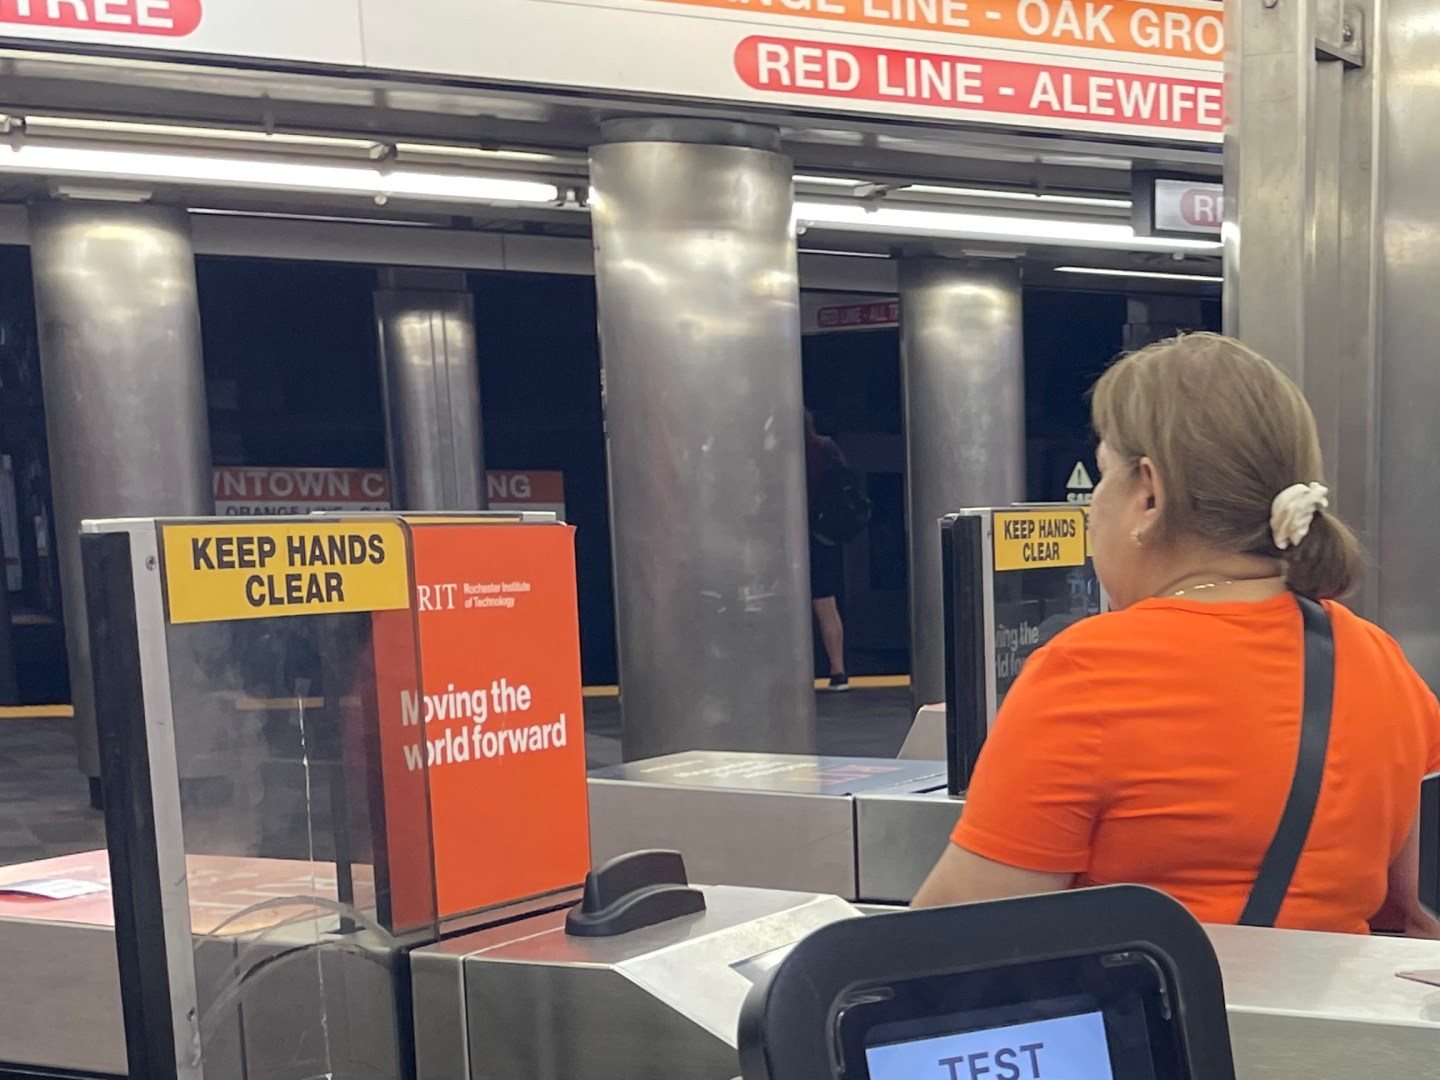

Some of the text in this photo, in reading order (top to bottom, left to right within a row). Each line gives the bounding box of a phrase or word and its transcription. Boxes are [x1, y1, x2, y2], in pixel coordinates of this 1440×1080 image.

[863, 0, 971, 28] LINE
[1017, 0, 1116, 44] OAK
[1130, 8, 1224, 55] GRO
[757, 42, 860, 91] RED
[877, 54, 984, 105] LINE
[1029, 70, 1222, 126] ALEWIFE
[1004, 518, 1076, 540] KEEP HANDS
[192, 534, 385, 571] KEEP HANDS
[1022, 542, 1060, 562] CLEAR
[245, 572, 345, 607] CLEAR
[417, 581, 531, 612] RIT Rochester Institute
[464, 596, 515, 609] of Technology
[400, 678, 532, 727] Moving the
[403, 713, 567, 772] world forward
